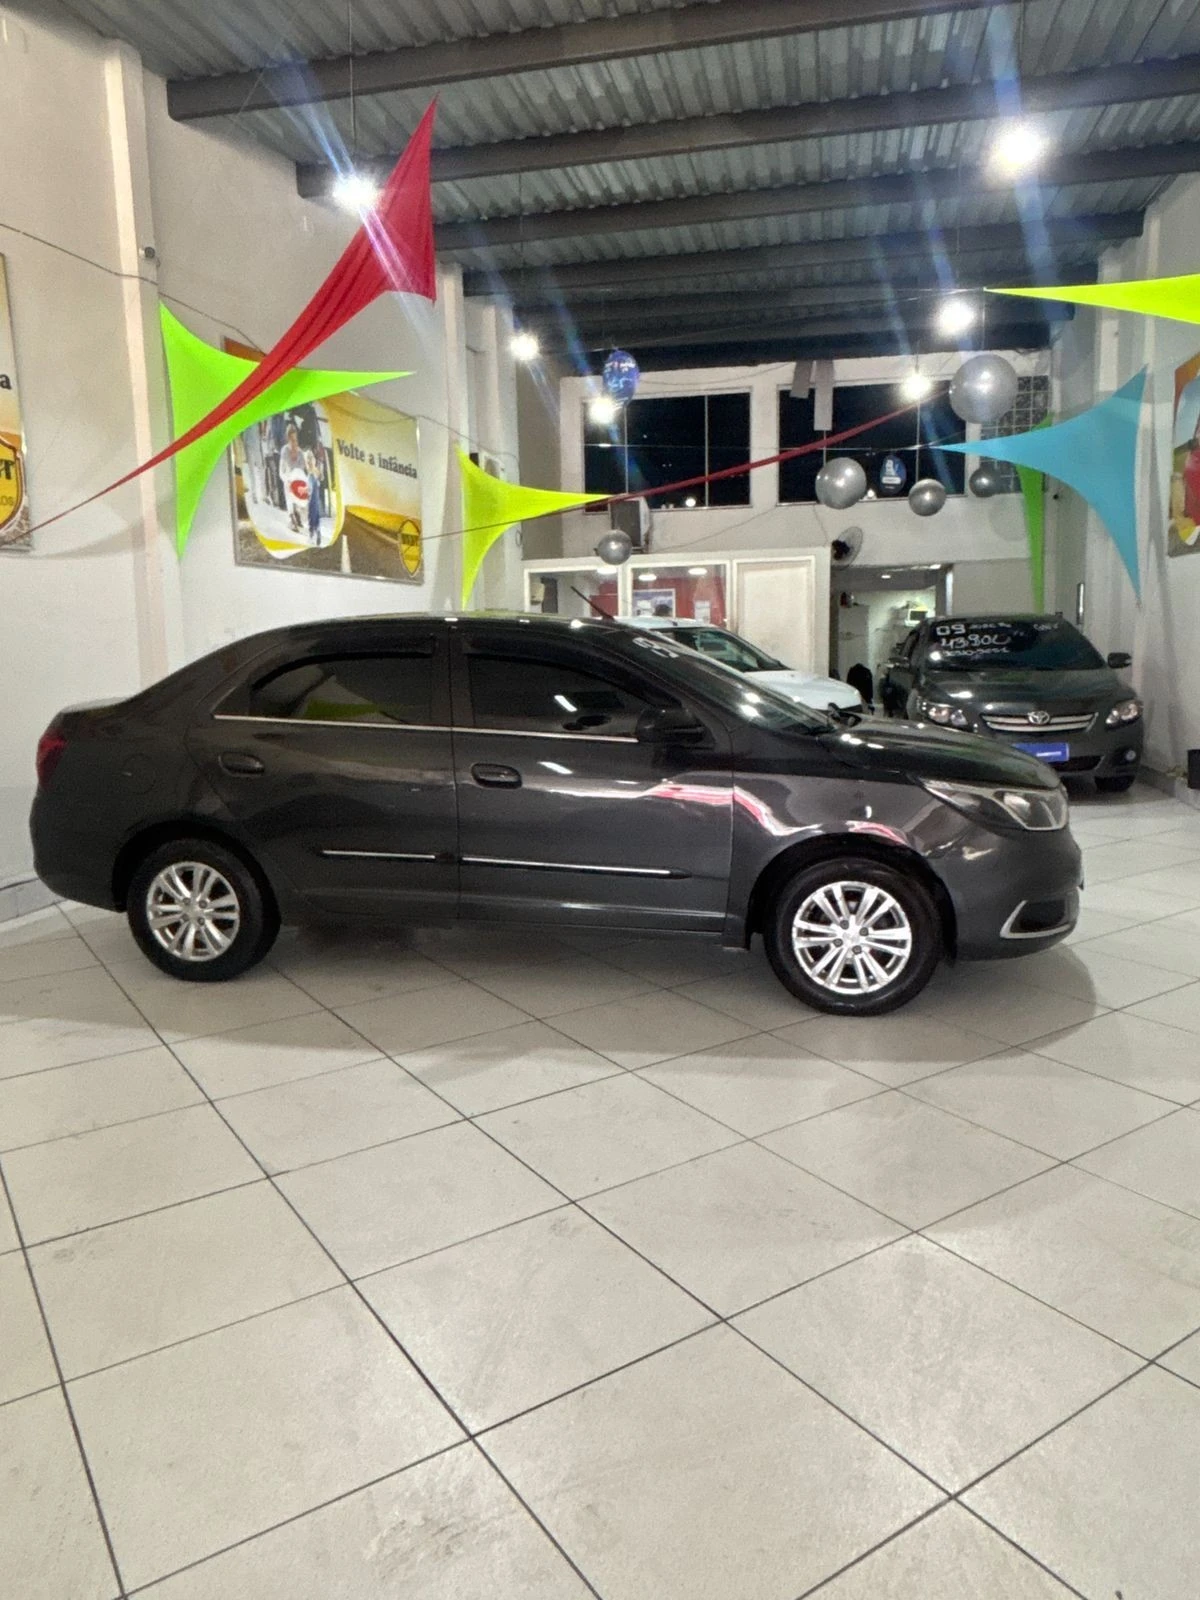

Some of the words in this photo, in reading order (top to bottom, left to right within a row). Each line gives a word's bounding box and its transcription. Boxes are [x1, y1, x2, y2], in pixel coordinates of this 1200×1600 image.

[336, 438, 366, 462] Volte
[368, 453, 375, 466] a
[378, 452, 417, 479] infância
